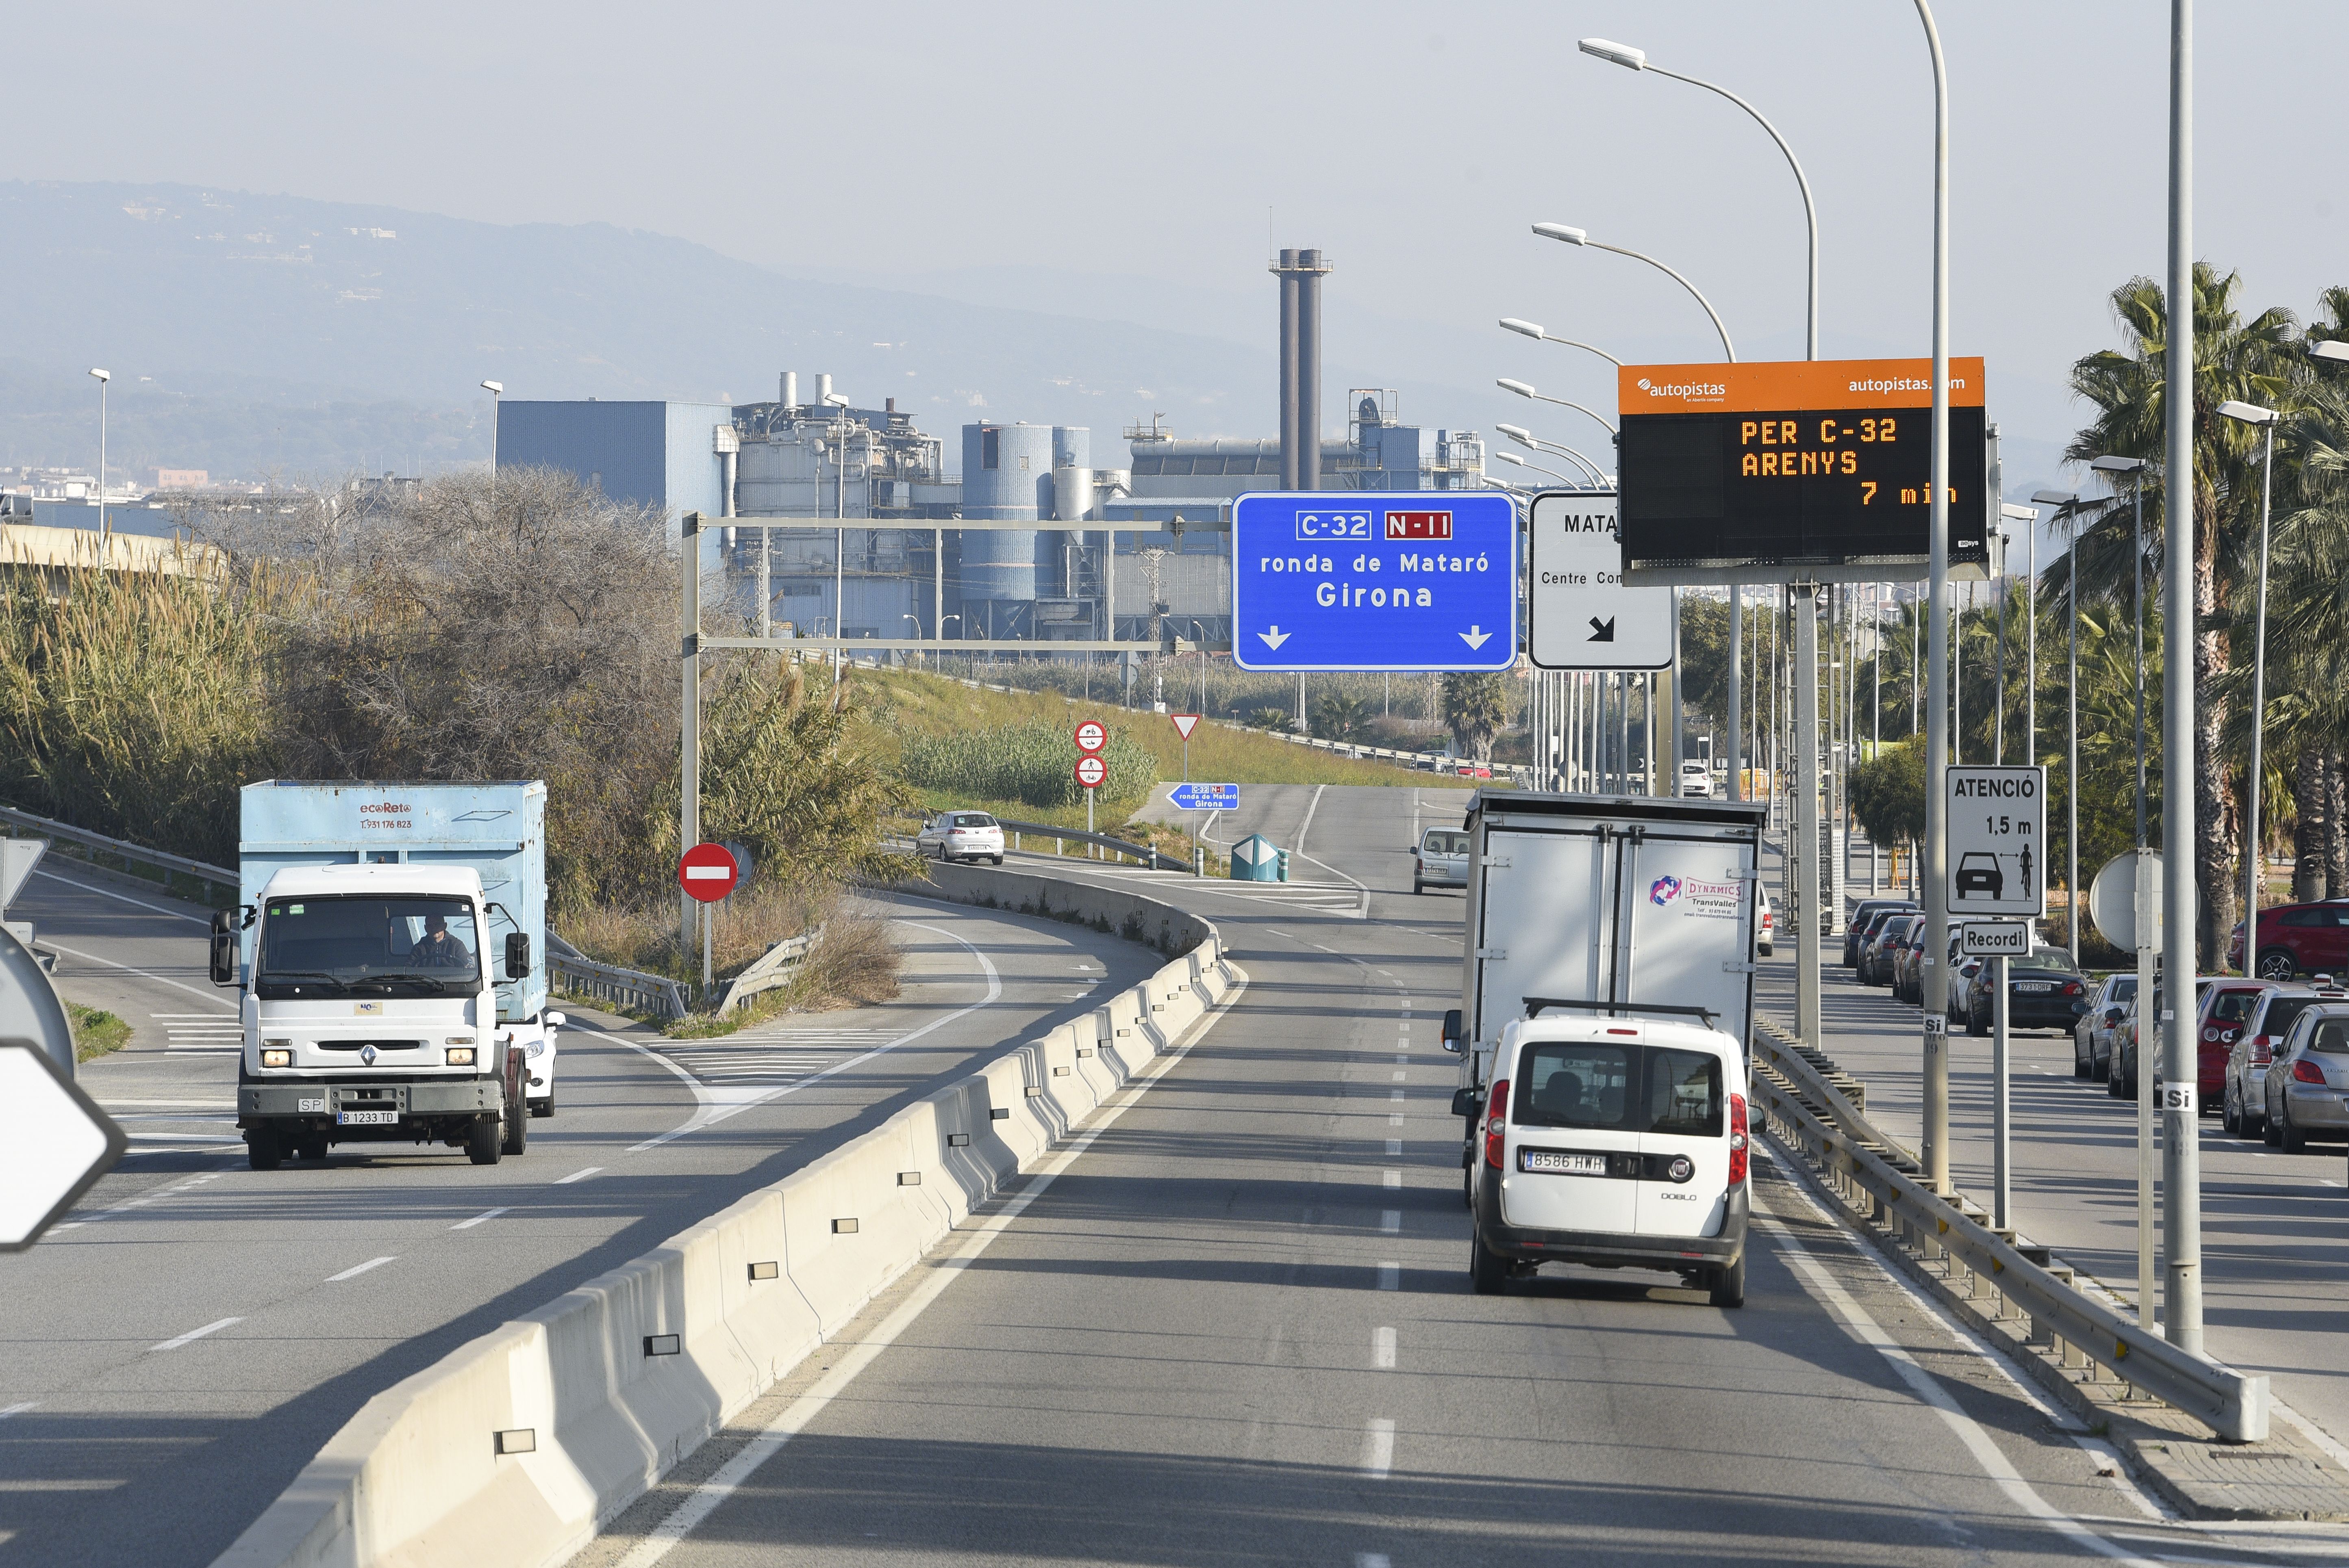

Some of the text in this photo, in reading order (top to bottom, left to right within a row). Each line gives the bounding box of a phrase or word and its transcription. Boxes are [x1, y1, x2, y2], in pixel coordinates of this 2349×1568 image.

[1650, 381, 1725, 400] autopistas
[1849, 377, 1965, 395] autopistas.m
[1742, 418, 1896, 445] PER C-32
[1743, 451, 1856, 476] ARENYS
[1861, 482, 1876, 505] 7
[1302, 515, 1367, 536] C-32
[1261, 552, 1489, 572] ronda de Mataró
[1542, 571, 1587, 584] Centre
[1317, 582, 1432, 608] Girona
[1955, 775, 2034, 798] ATENCIÓ
[382, 820, 395, 829] 176
[397, 820, 412, 828] 823
[1986, 816, 2032, 836] 1,5 m
[1689, 883, 1741, 896] DYNAMICS
[1692, 898, 1736, 908] TransValles
[1968, 931, 2022, 947] Recordi
[1925, 1019, 1941, 1032] Si
[2167, 1089, 2189, 1108] Si
[343, 1112, 393, 1123] B 1233 TD
[1534, 1153, 1602, 1170] 8586 HWH
[1661, 1193, 1697, 1201] DOBLO
